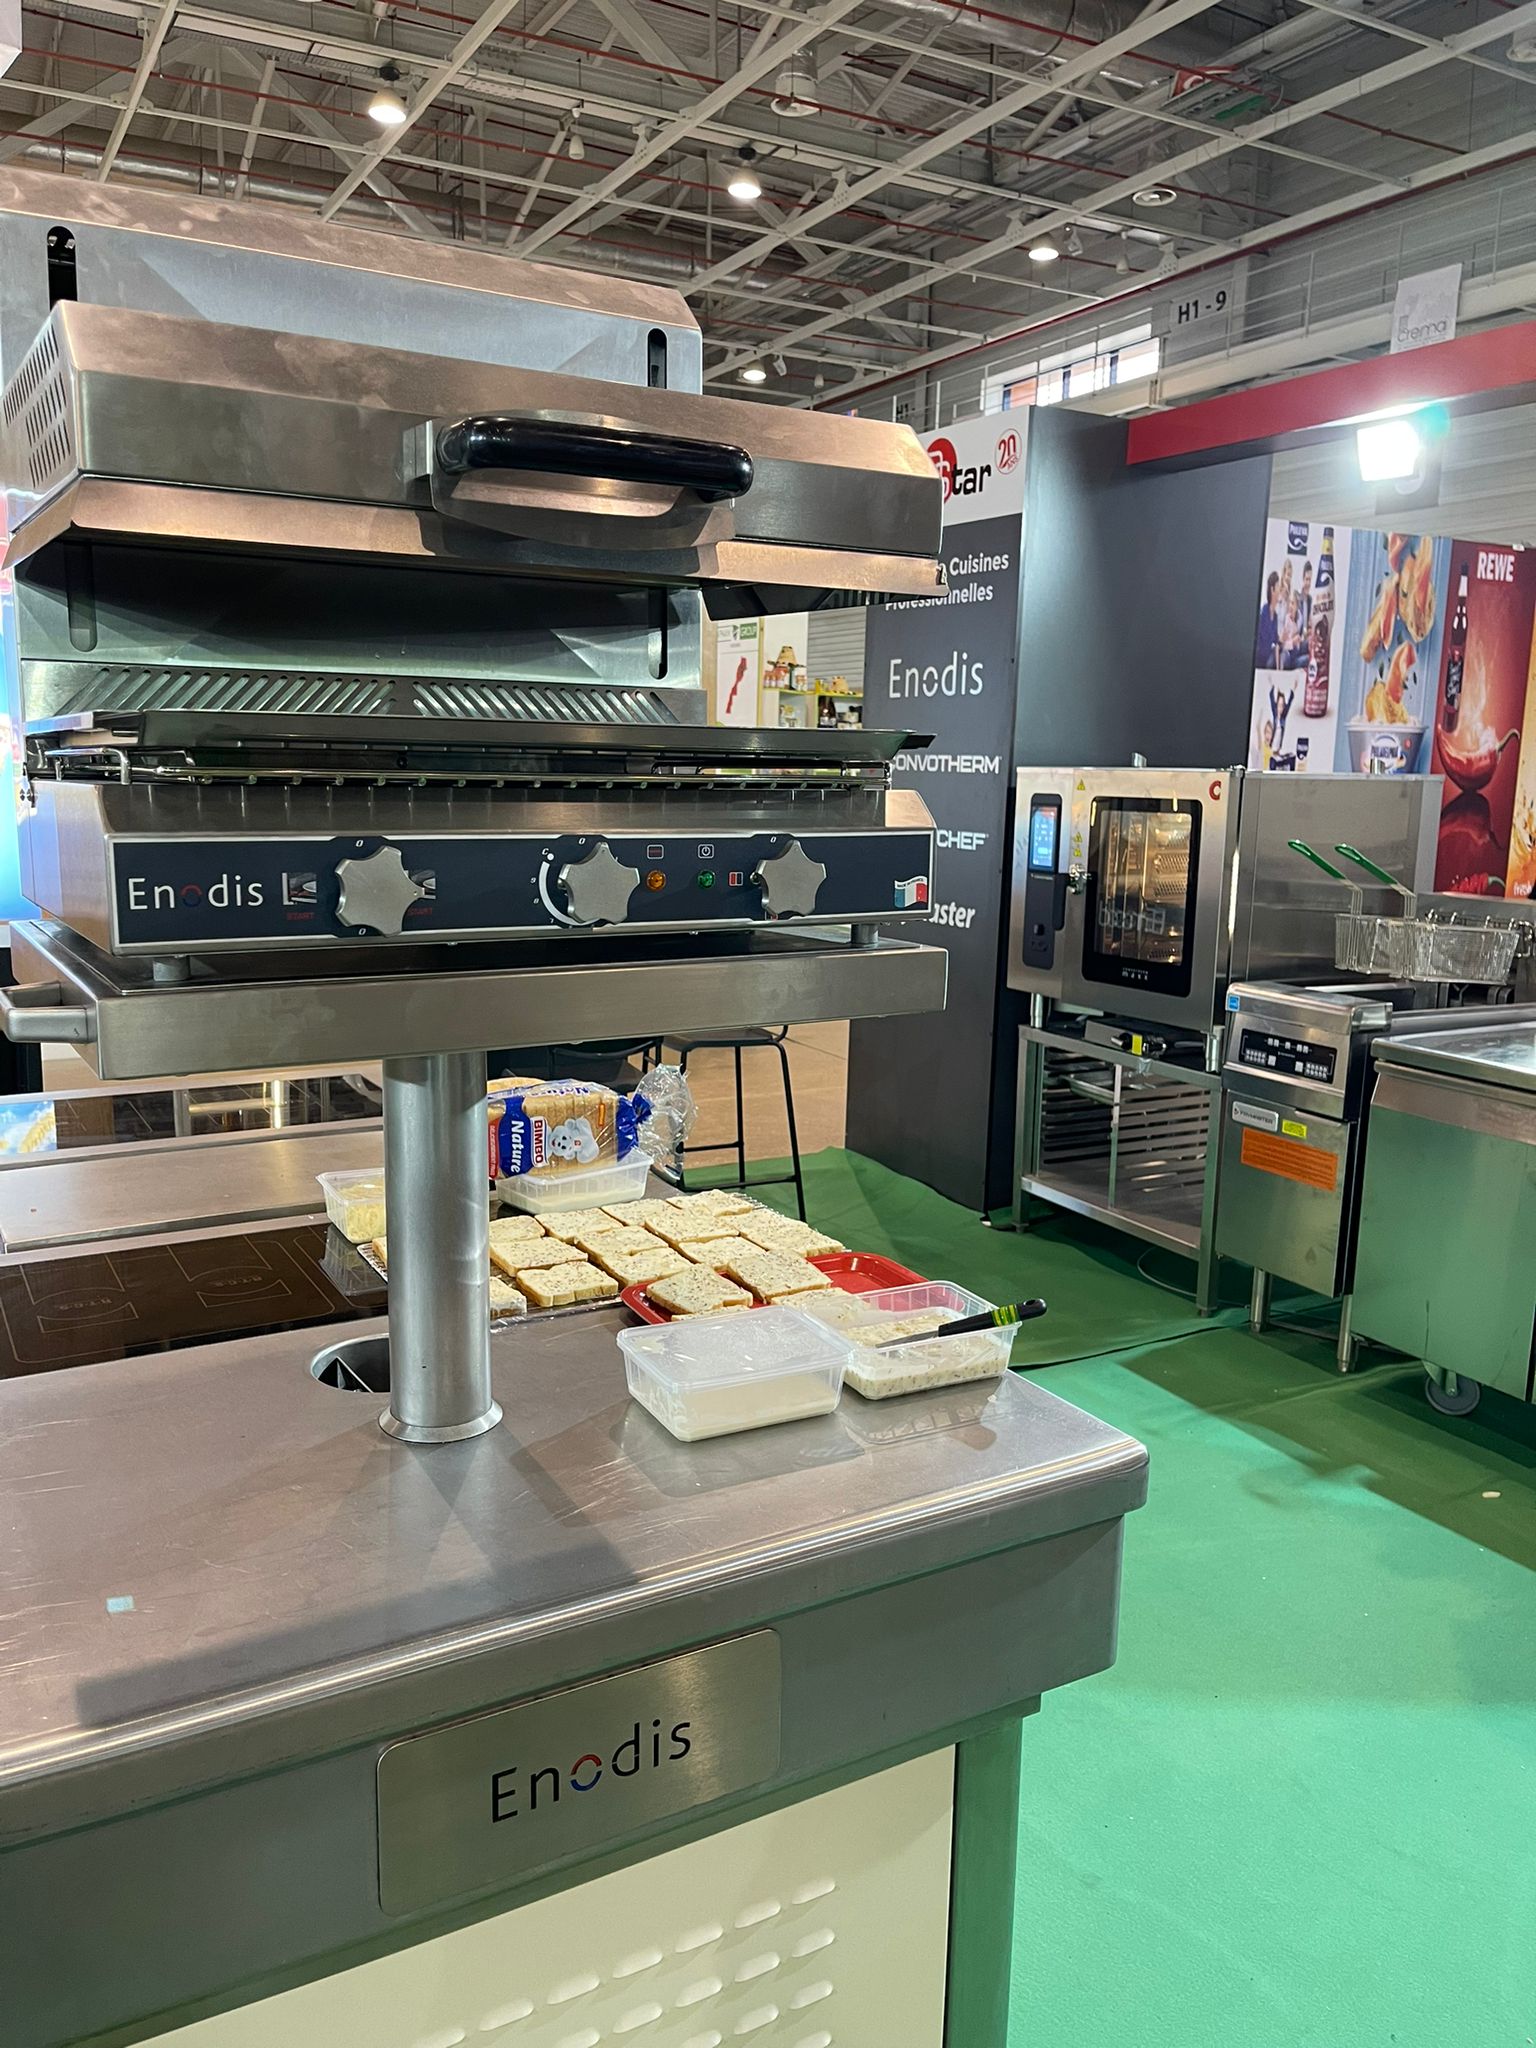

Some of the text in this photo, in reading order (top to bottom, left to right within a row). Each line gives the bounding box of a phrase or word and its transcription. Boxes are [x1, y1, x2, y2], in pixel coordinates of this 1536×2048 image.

[1178, 299, 1199, 324] H1
[1215, 290, 1227, 312] 9
[949, 552, 1009, 576] Cuisines
[1476, 551, 1515, 583] REWE
[885, 582, 994, 611] Professionnelles
[888, 650, 984, 699] Enodis
[936, 829, 986, 851] CHEF
[127, 873, 264, 911] Enodis
[929, 901, 976, 928] aster
[511, 1120, 525, 1173] Nature
[533, 1119, 544, 1164] BIMBO
[491, 1718, 692, 1824] Enodis
